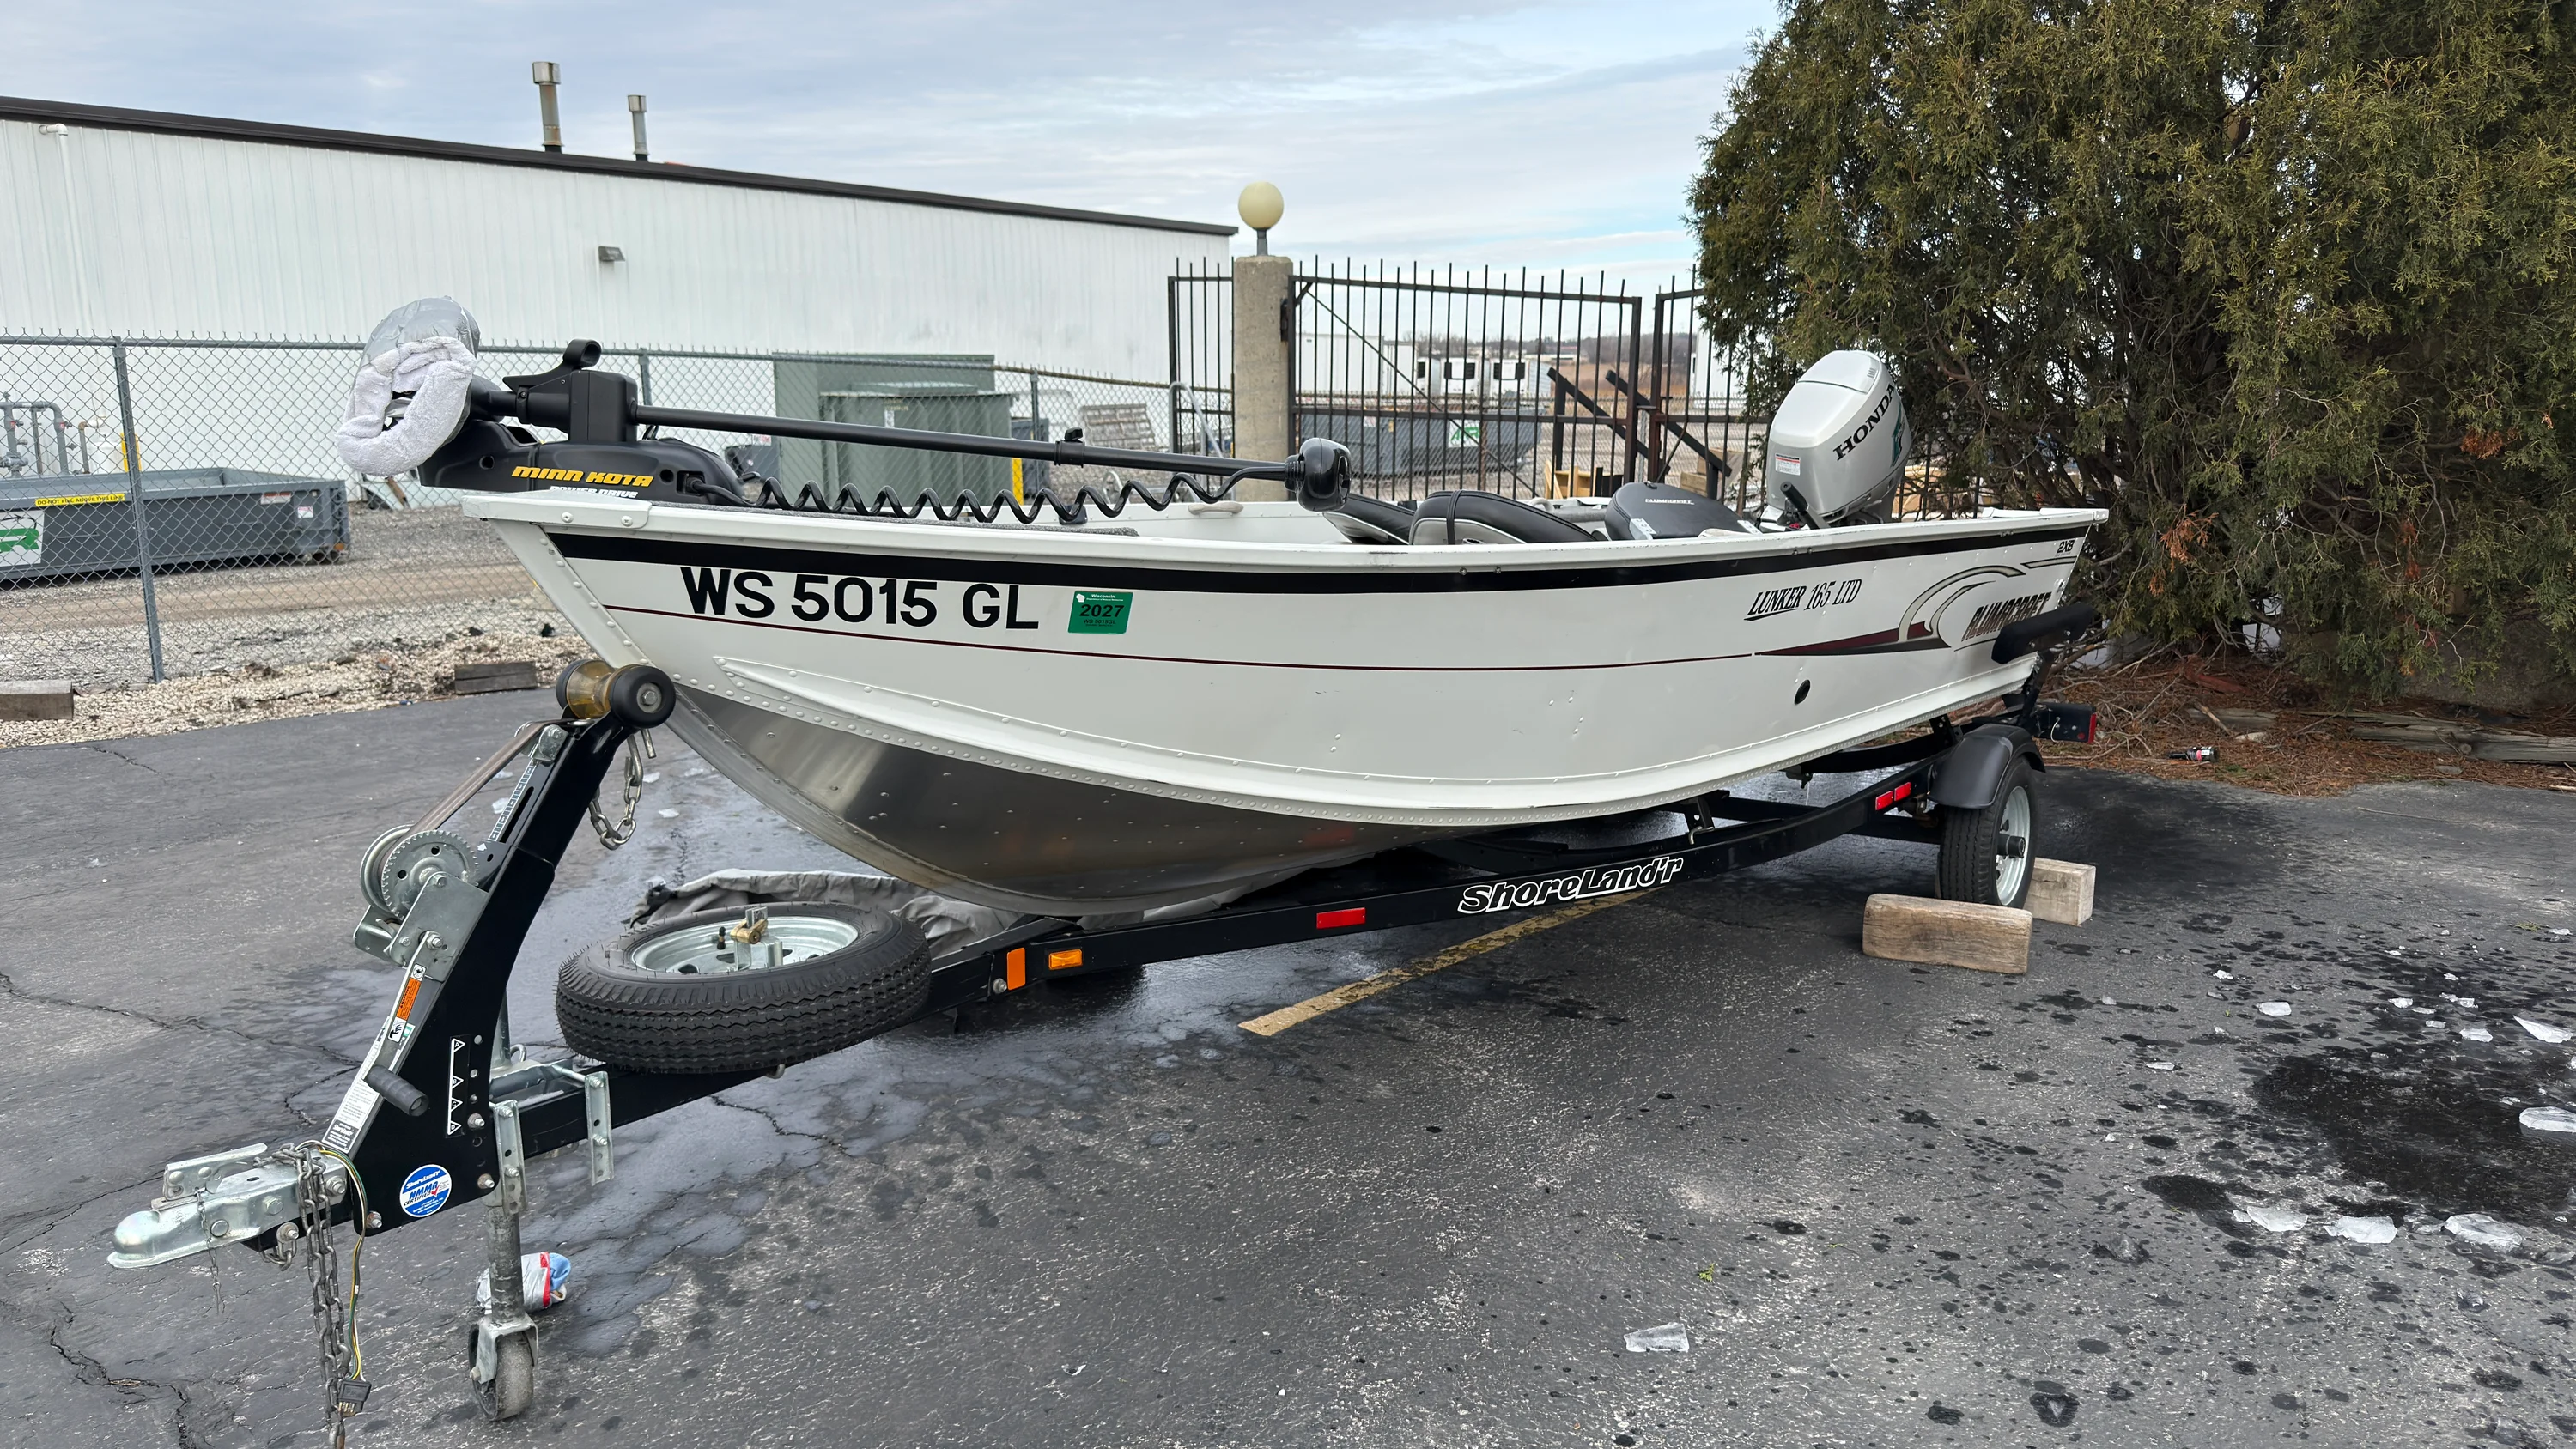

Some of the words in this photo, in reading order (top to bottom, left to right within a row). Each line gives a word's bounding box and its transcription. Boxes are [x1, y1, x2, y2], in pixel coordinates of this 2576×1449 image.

[1832, 383, 1895, 462] HONDA
[511, 465, 584, 482] MINN
[586, 471, 654, 488] KOTA
[598, 489, 639, 499] DRIVE
[2057, 540, 2075, 553] 2XB
[680, 566, 775, 619] WS
[791, 573, 938, 627] 5015
[963, 583, 1039, 629] GL
[1747, 585, 1807, 616] LUNKER
[1803, 580, 1837, 611] 165
[1832, 579, 1862, 605] LTD
[1079, 603, 1125, 617] 2027
[1457, 856, 1684, 914] ShoreLand'r
[404, 1191, 432, 1206] CERTIFIED
